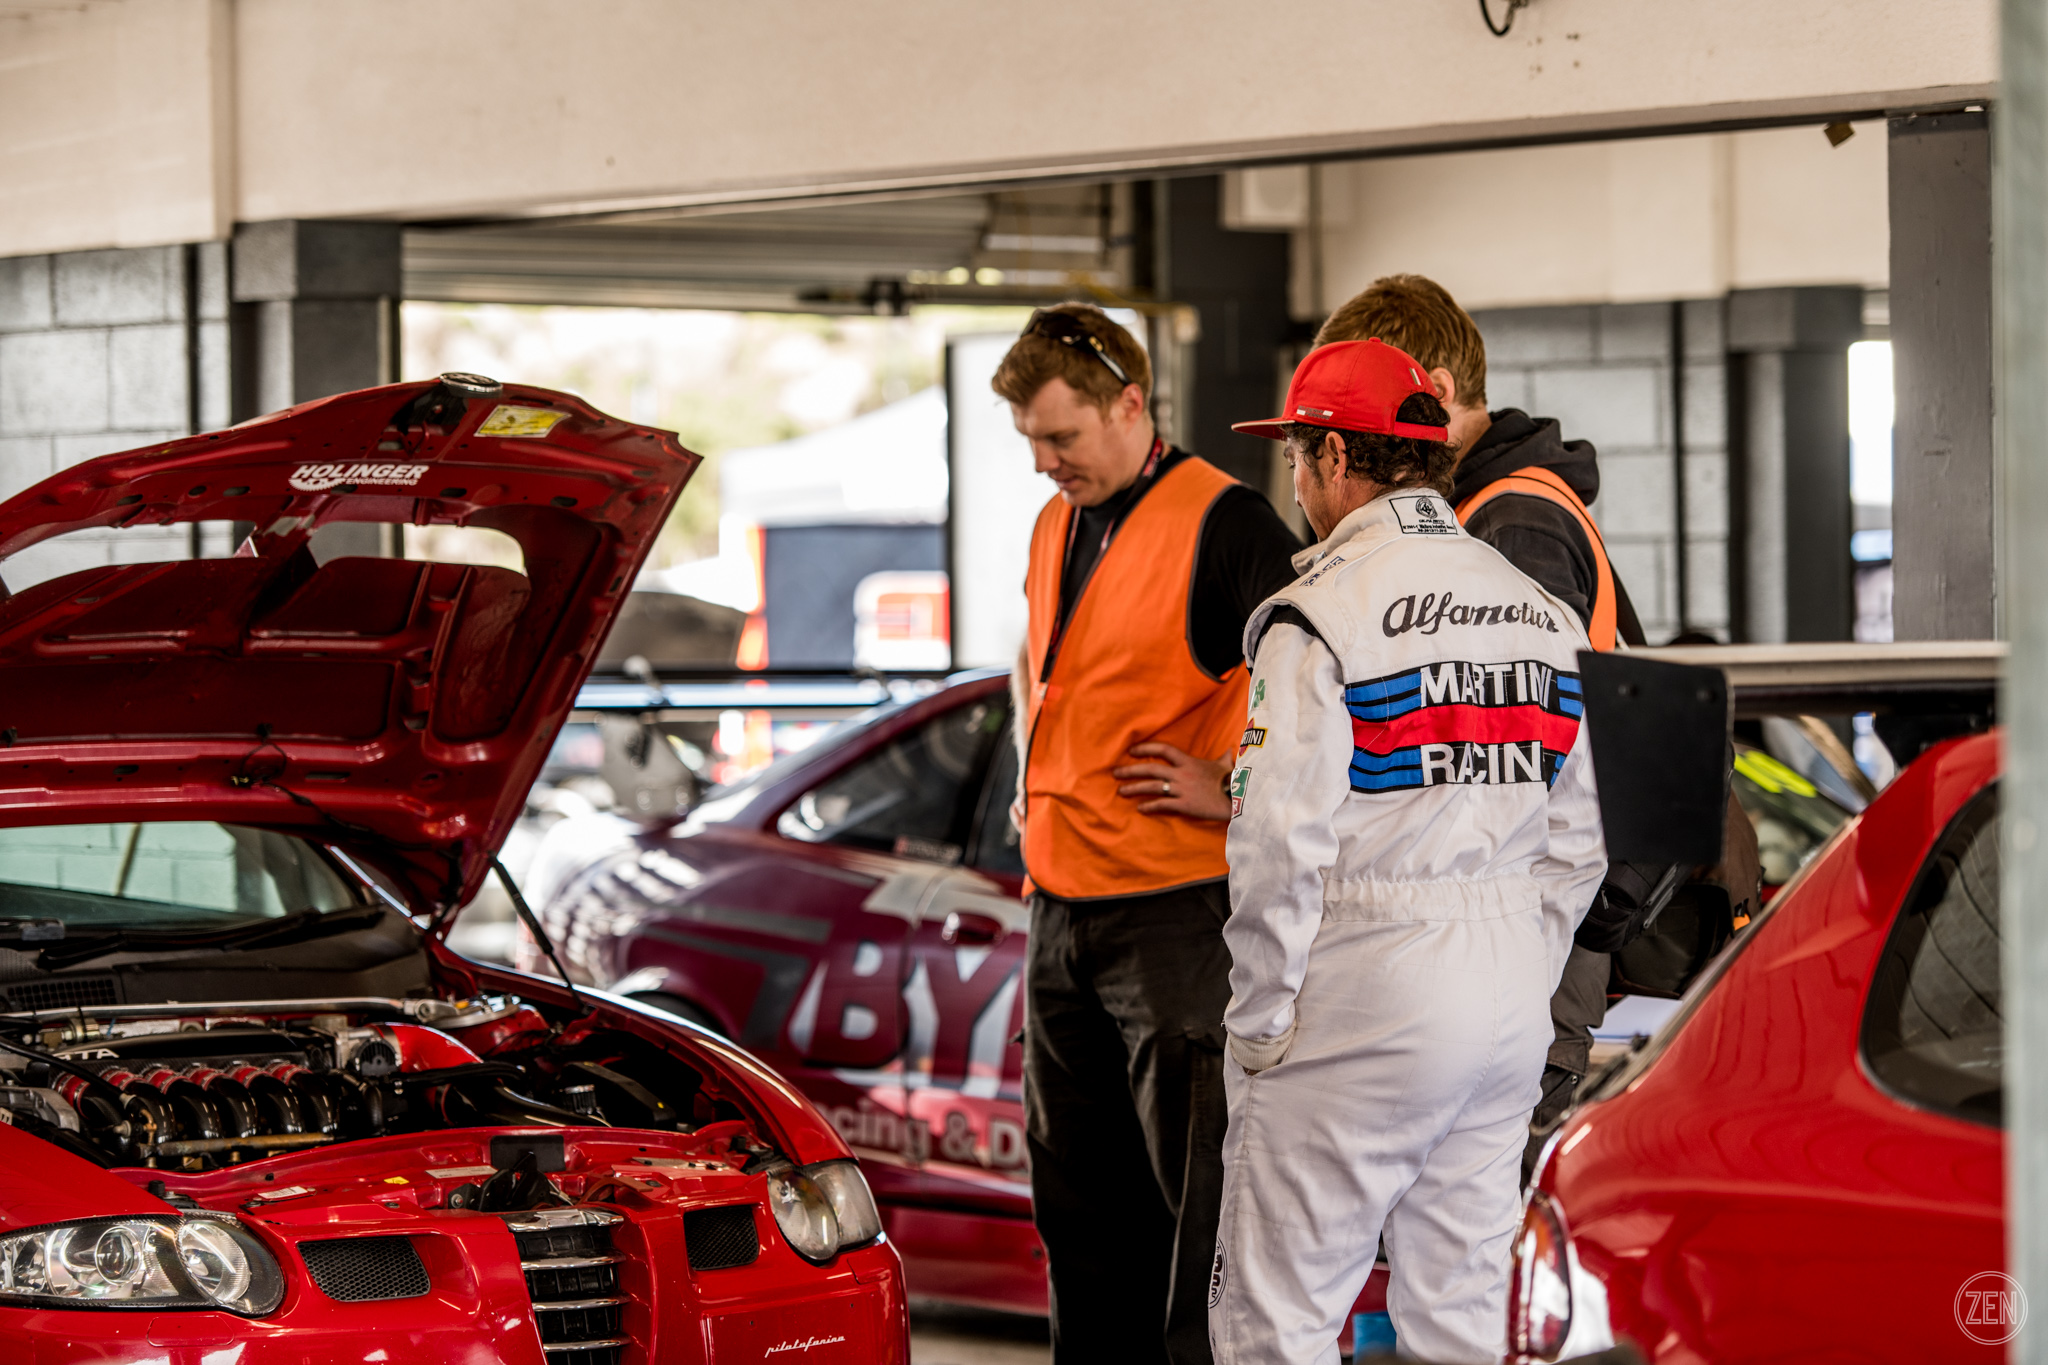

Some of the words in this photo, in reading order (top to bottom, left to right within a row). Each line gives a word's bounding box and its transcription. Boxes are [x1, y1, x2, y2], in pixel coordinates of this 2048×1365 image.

[290, 463, 430, 479] HOLINGER
[344, 478, 419, 486] ENGINEERING
[1420, 661, 1553, 709] MARTINI
[1420, 741, 1543, 787] RACIN
[940, 1111, 975, 1160] &
